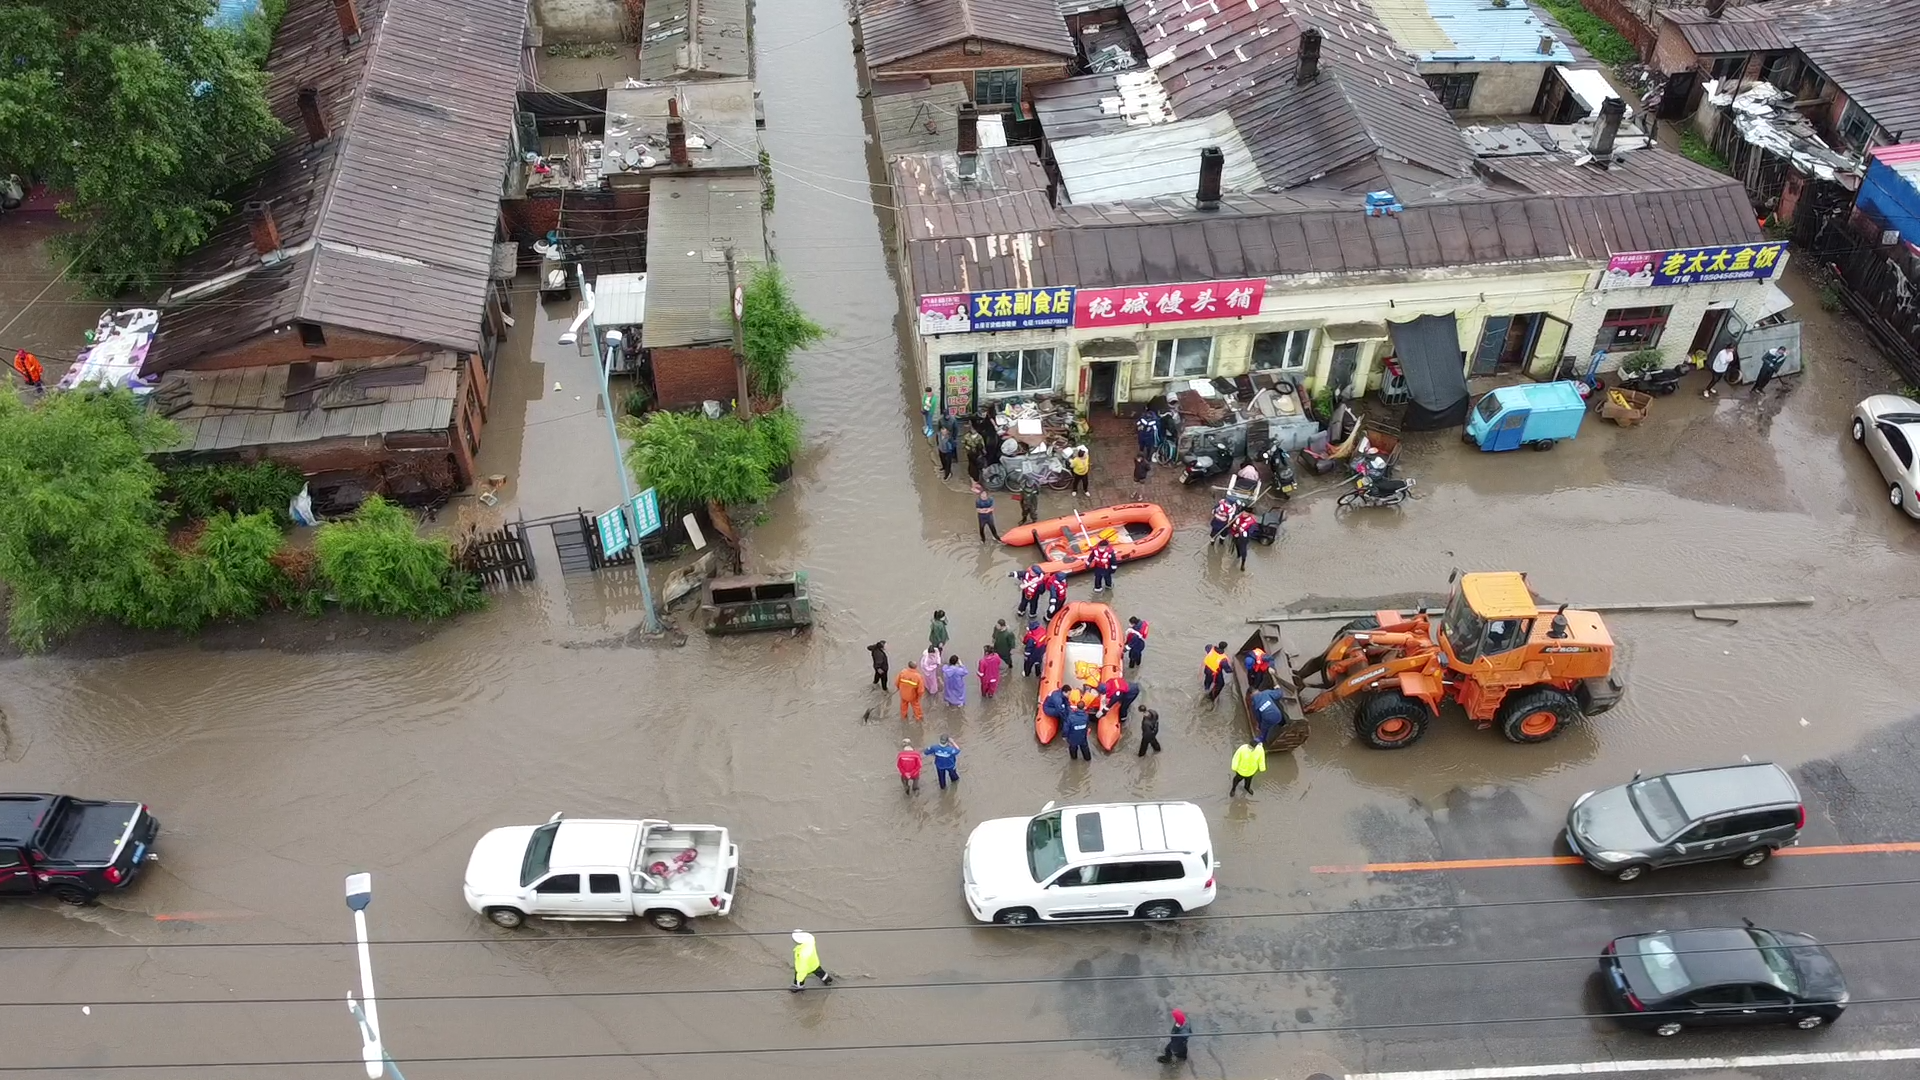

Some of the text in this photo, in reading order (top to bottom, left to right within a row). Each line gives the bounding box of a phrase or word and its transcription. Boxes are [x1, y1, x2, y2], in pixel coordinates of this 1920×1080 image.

[1660, 245, 1781, 276] 老太太盒饭
[974, 289, 1072, 318] 文杰副食店
